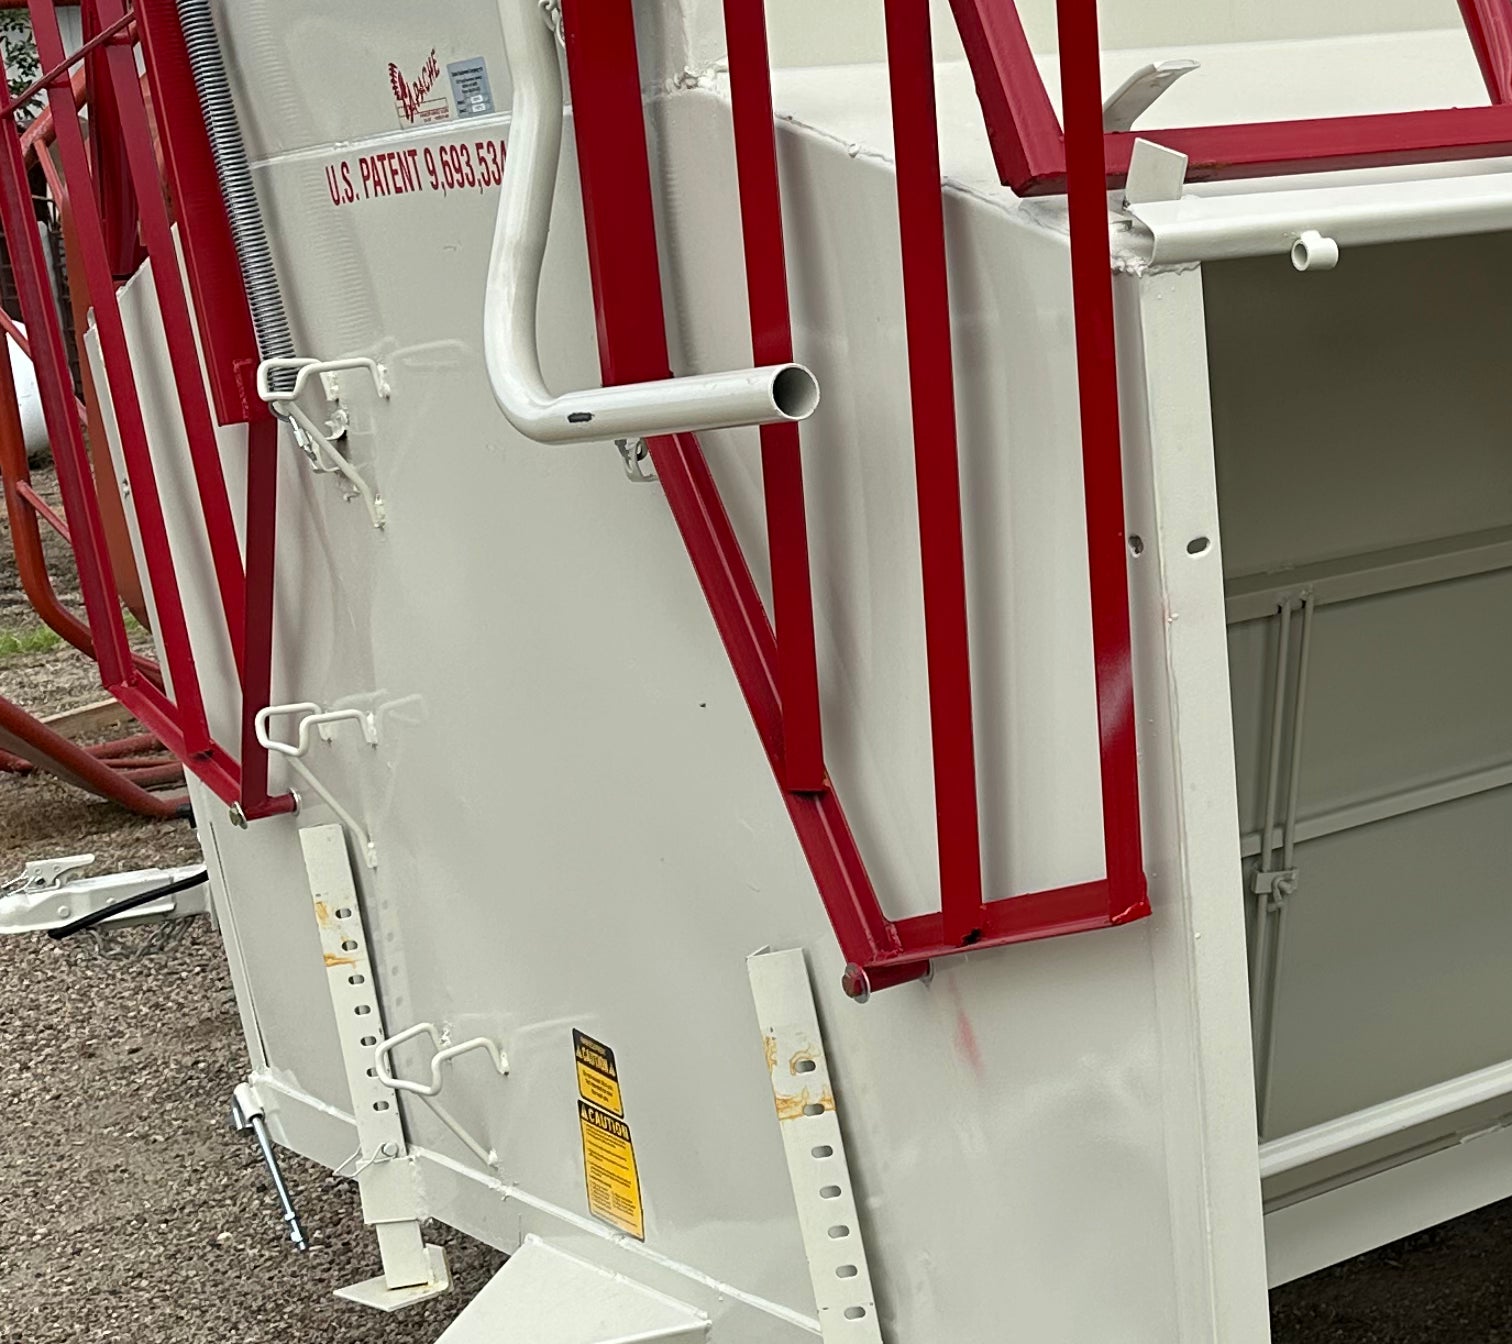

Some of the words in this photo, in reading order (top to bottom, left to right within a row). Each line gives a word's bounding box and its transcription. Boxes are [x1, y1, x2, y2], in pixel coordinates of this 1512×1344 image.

[325, 161, 360, 206] U.S.
[359, 149, 422, 199] PATENT
[588, 1108, 629, 1141] CAUTION
